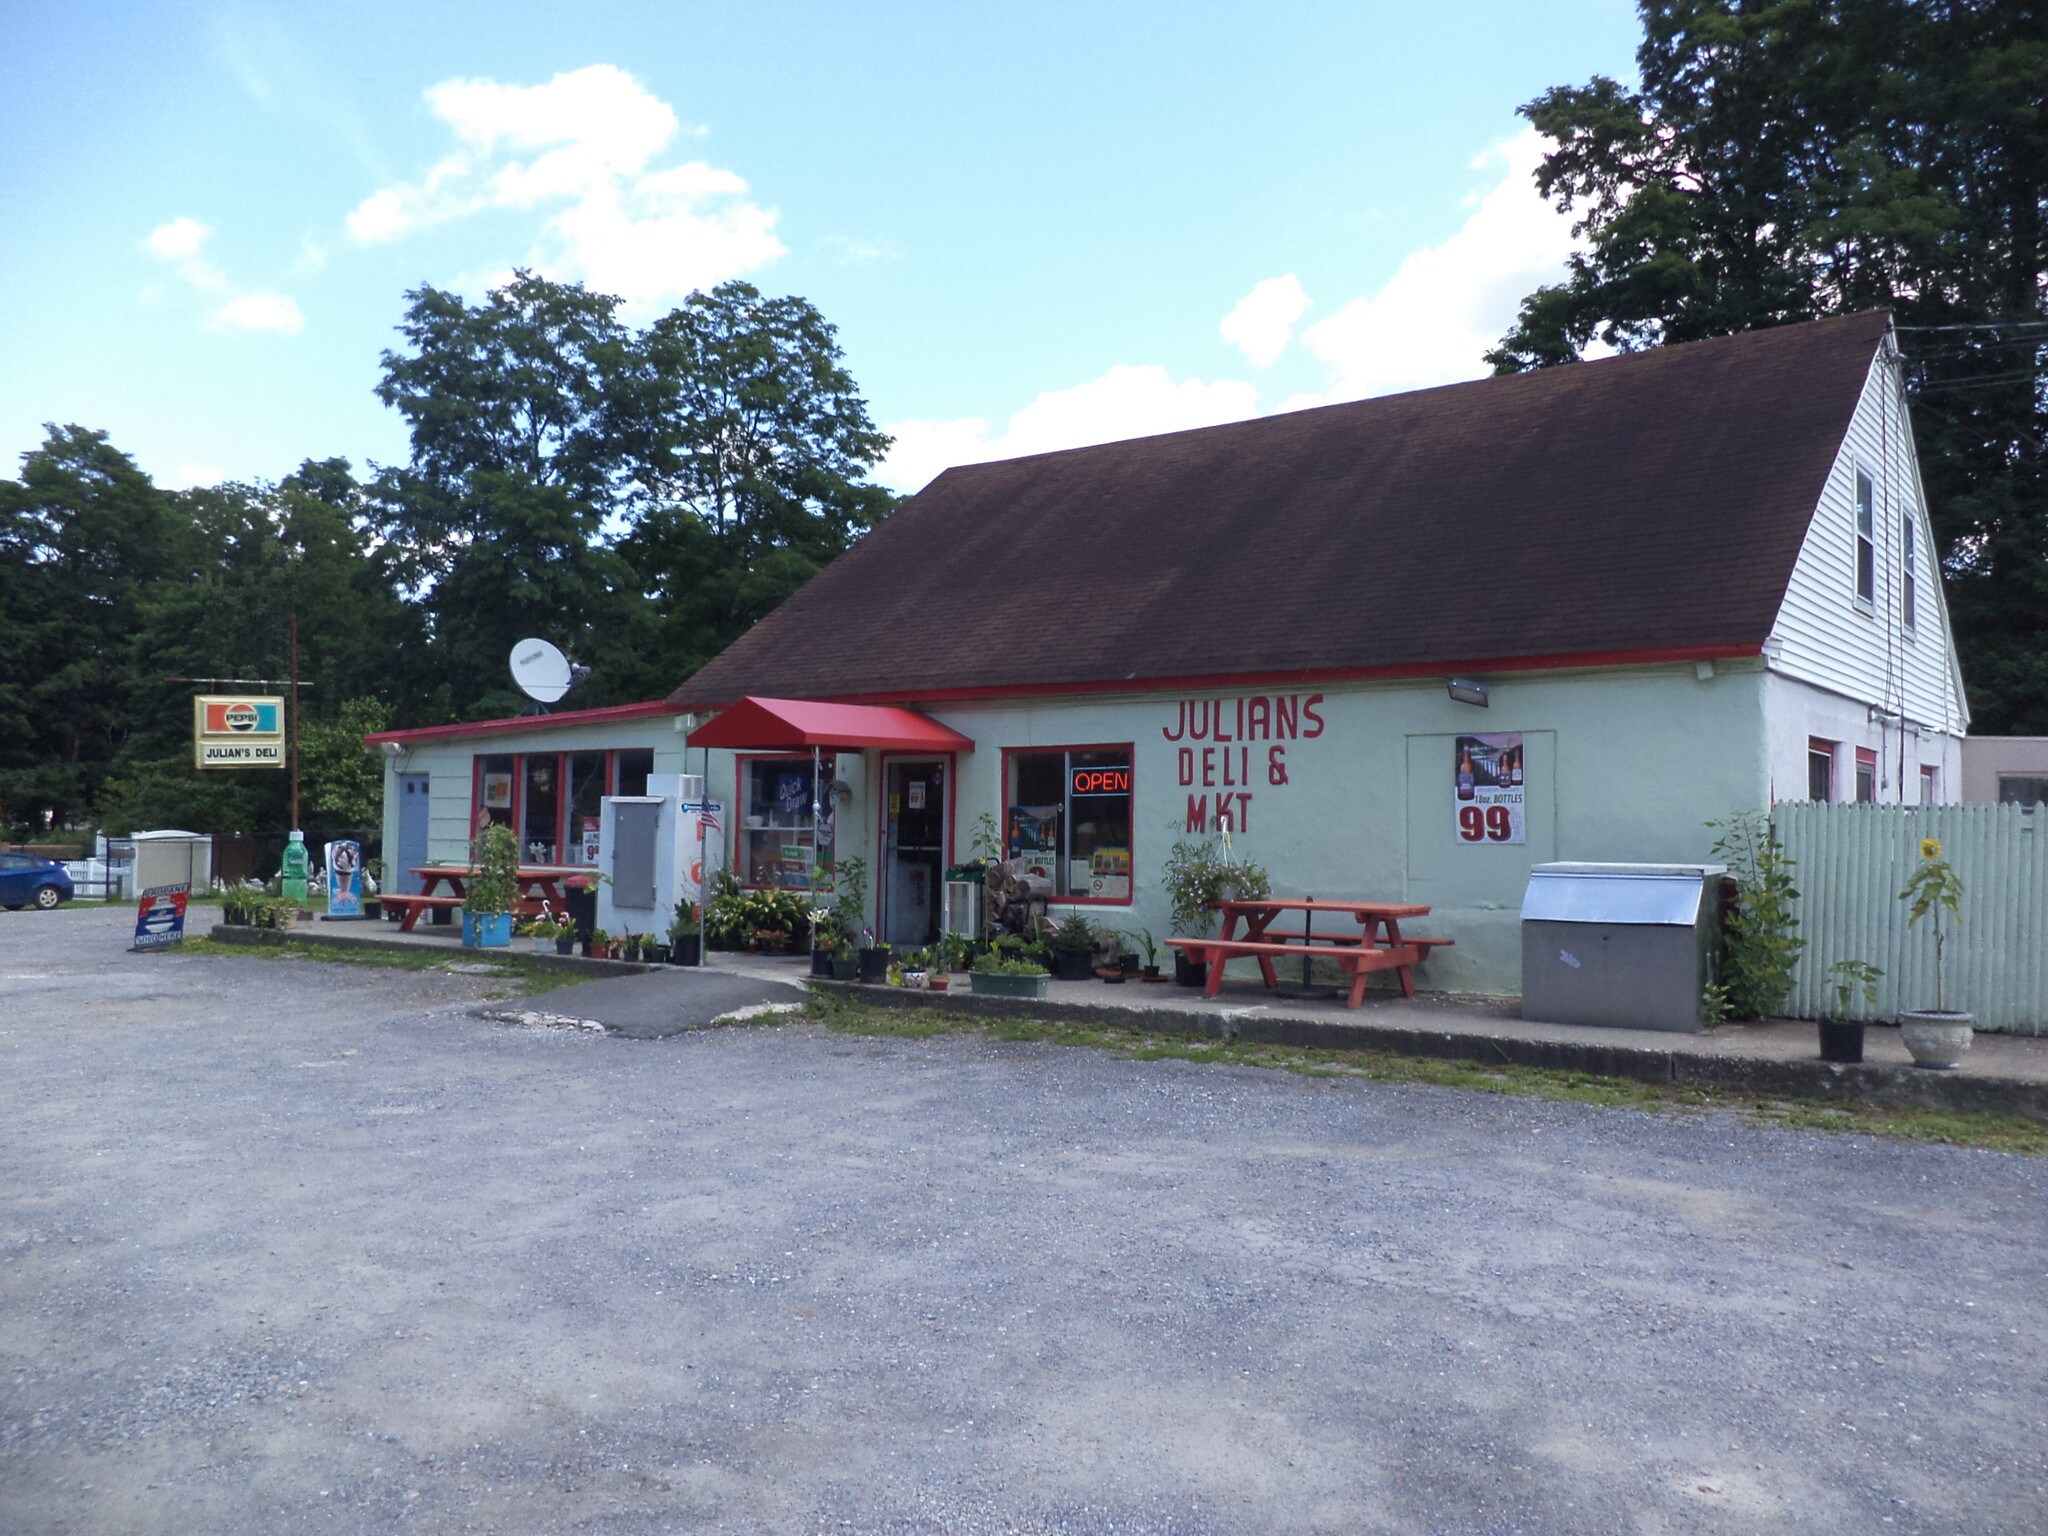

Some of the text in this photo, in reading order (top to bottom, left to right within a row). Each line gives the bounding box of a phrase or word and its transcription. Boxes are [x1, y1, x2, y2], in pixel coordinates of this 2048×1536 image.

[226, 713, 258, 722] PEPSI
[1162, 694, 1325, 742] JULIANS
[206, 748, 278, 758] JULIAN'S DELI
[1178, 744, 1289, 787] DELI &
[779, 776, 803, 800] Quick
[1075, 772, 1128, 791] OPEN
[785, 792, 808, 813] Draw
[1493, 794, 1523, 804] BOTTLES
[1186, 792, 1253, 833] MKT
[1459, 805, 1512, 842] 99
[1034, 857, 1055, 866] BOTTLES
[135, 933, 158, 945] SOLD
